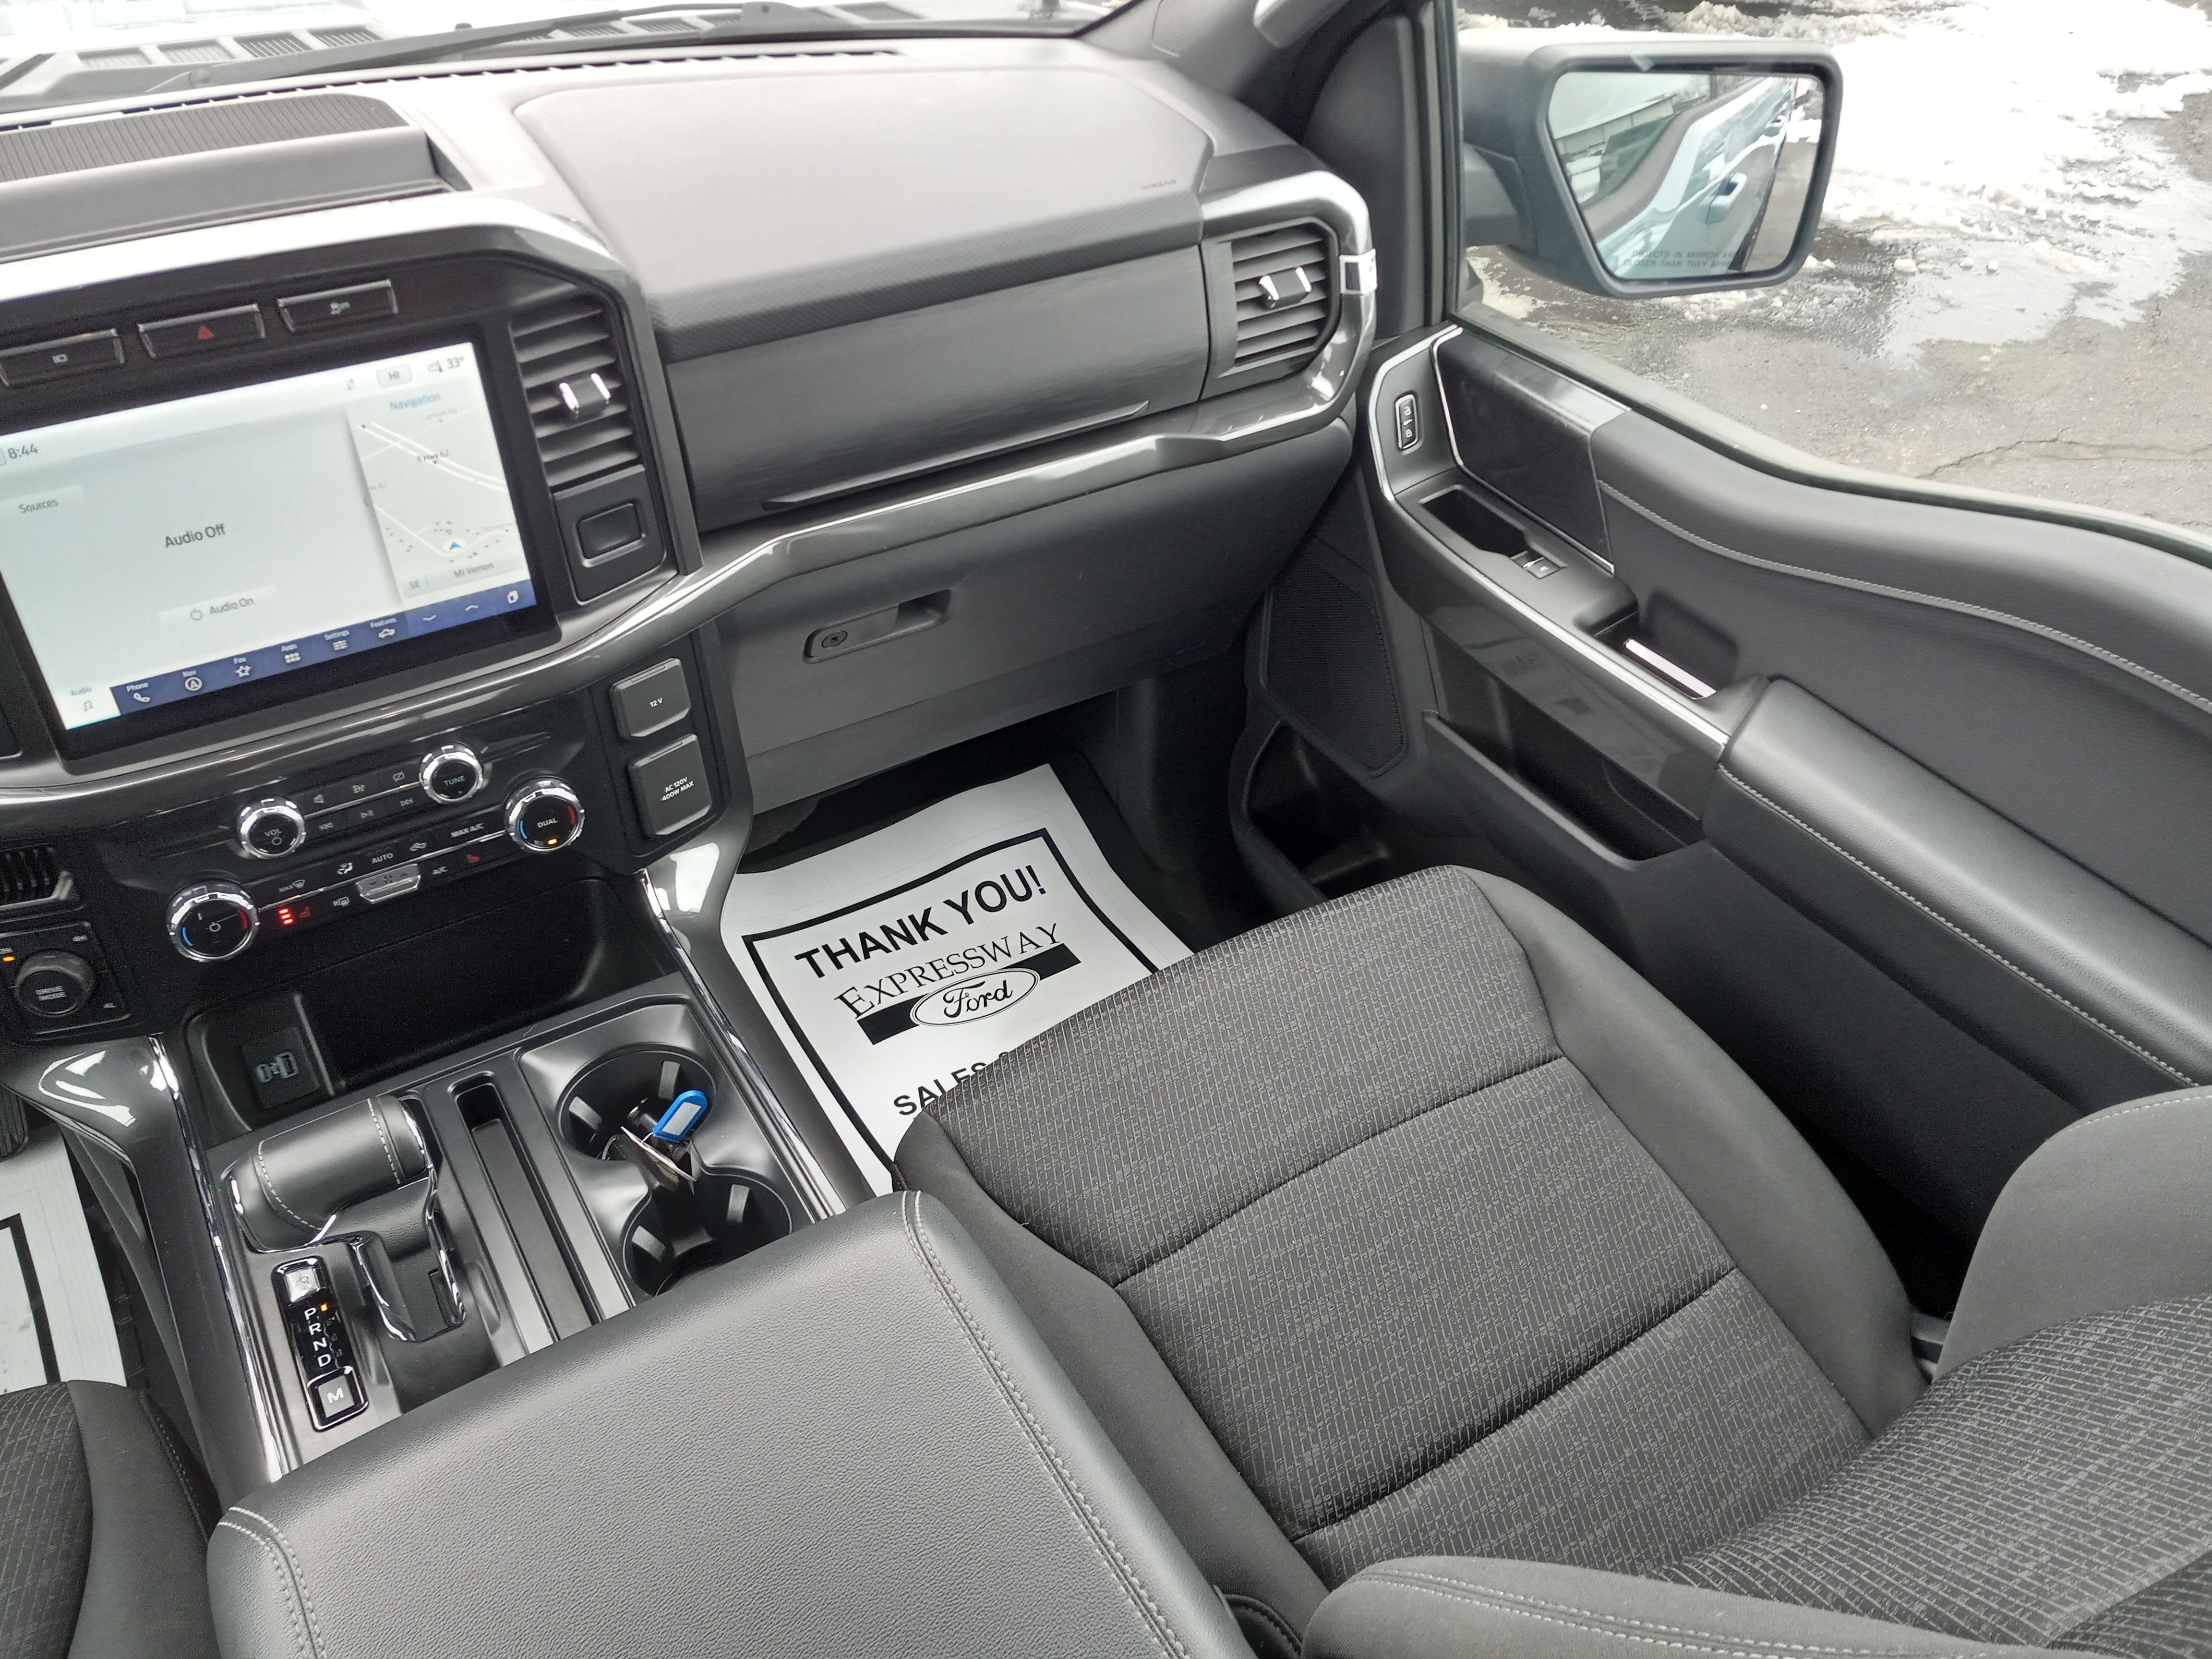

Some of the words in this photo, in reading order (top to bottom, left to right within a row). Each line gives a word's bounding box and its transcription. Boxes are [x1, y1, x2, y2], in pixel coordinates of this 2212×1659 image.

[1633, 250, 1670, 258] OBECTS
[389, 393, 441, 409] Navigation
[8, 444, 38, 459] 8:44
[417, 455, 423, 463] E
[423, 452, 439, 461] Hwy
[439, 449, 449, 457] 62
[19, 497, 59, 514] Sources
[165, 529, 203, 548] Audio
[204, 523, 226, 539] Off
[454, 569, 465, 577] Mt
[466, 563, 494, 575] Vernon
[409, 580, 421, 589] SE
[209, 601, 238, 615] Audio
[239, 596, 254, 608] On
[370, 617, 397, 629] Features
[324, 629, 351, 641] Settings
[71, 686, 92, 697] Audio
[126, 682, 149, 693] Phone
[649, 698, 658, 708] 12
[444, 775, 466, 786] TUNE
[665, 784, 674, 793] AC
[673, 776, 688, 788] 120V
[661, 789, 680, 801] 400W
[680, 781, 695, 793] MAX
[537, 817, 558, 828] DUAL
[264, 828, 282, 837] VOL
[372, 853, 394, 864] AUTO
[279, 884, 293, 893] MAX
[794, 906, 948, 978] THANK
[943, 865, 1048, 927] YOU!
[834, 923, 1062, 1019] EXPRESSWAY
[942, 980, 1014, 1019] Ford
[303, 1307, 316, 1320] P
[308, 1322, 322, 1336] R
[313, 1337, 327, 1351] N
[317, 1354, 331, 1368] D
[326, 1387, 344, 1404] M
